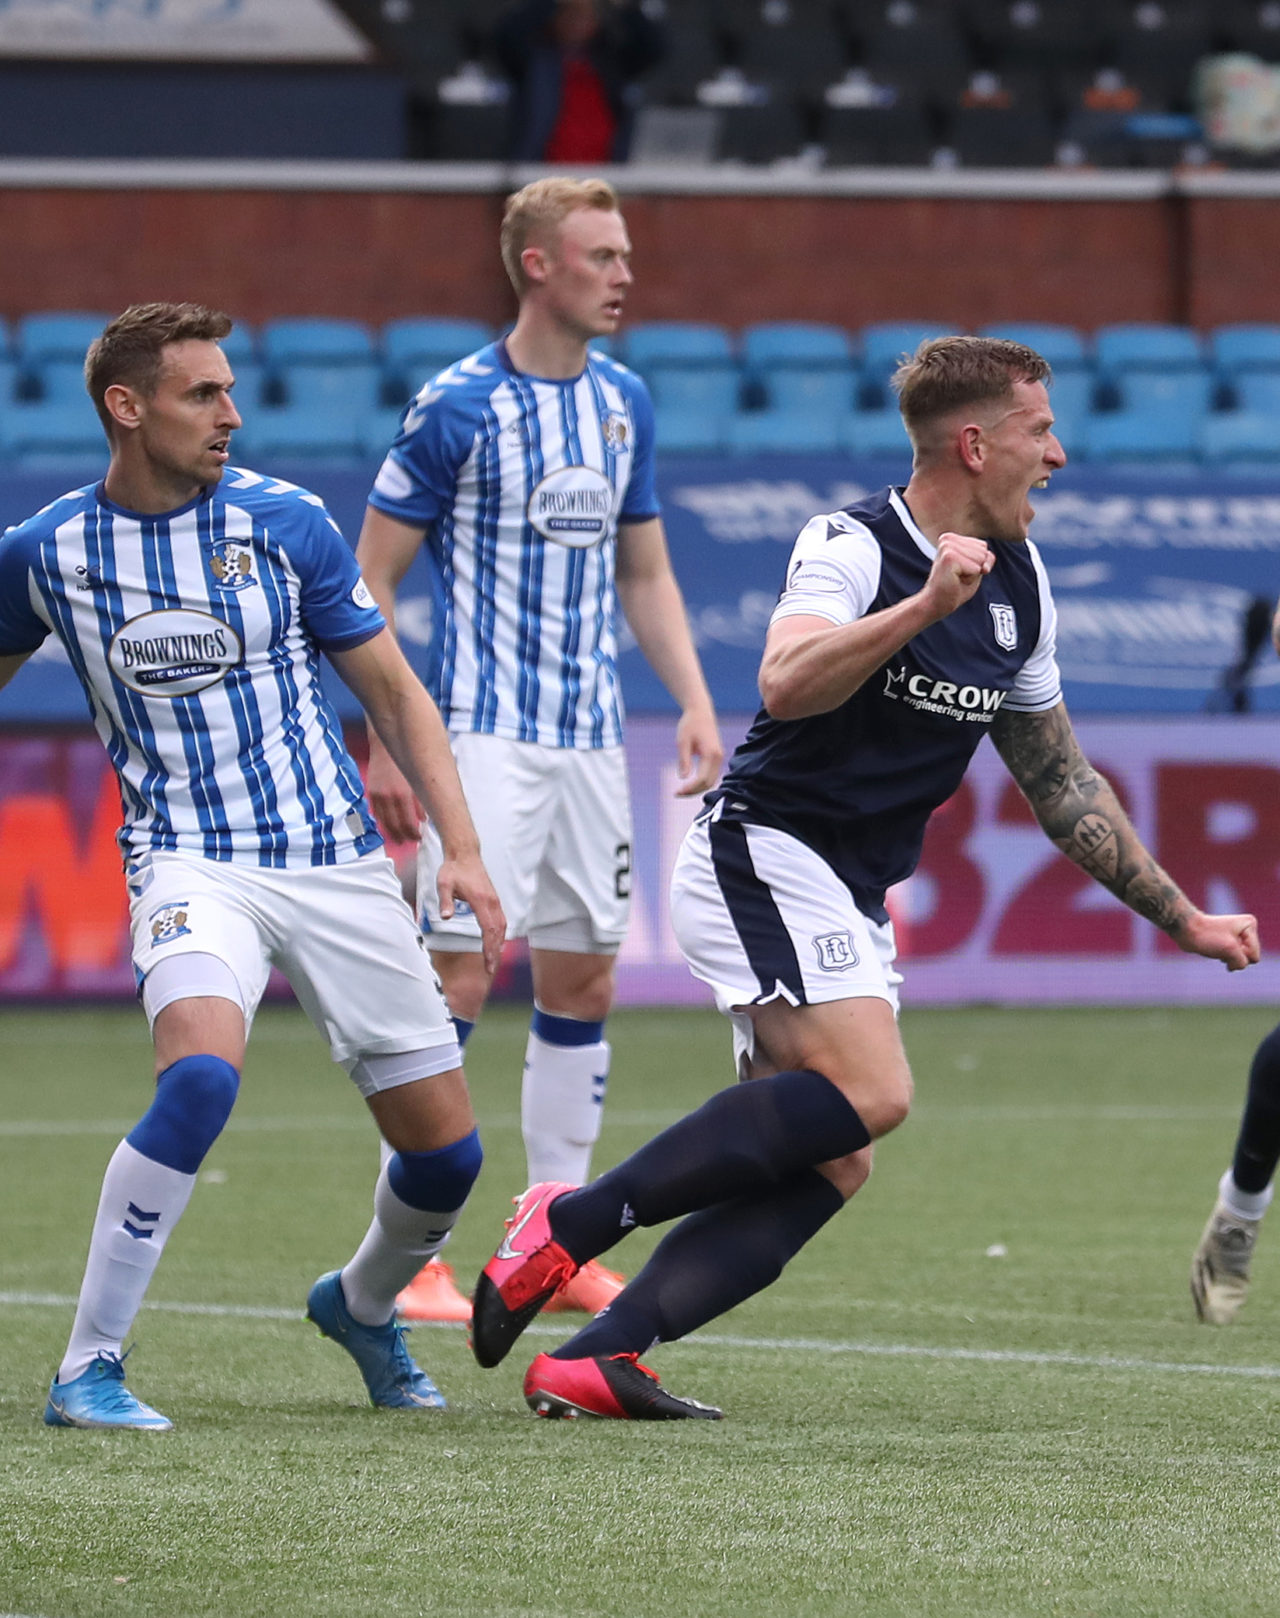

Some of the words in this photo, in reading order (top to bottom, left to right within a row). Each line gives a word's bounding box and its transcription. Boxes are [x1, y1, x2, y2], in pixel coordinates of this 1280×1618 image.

[539, 488, 609, 514] BROWNINGS
[118, 628, 228, 668] BROWNINGS
[142, 672, 165, 682] THE
[907, 674, 1008, 711] CROW
[903, 696, 965, 722] engineering
